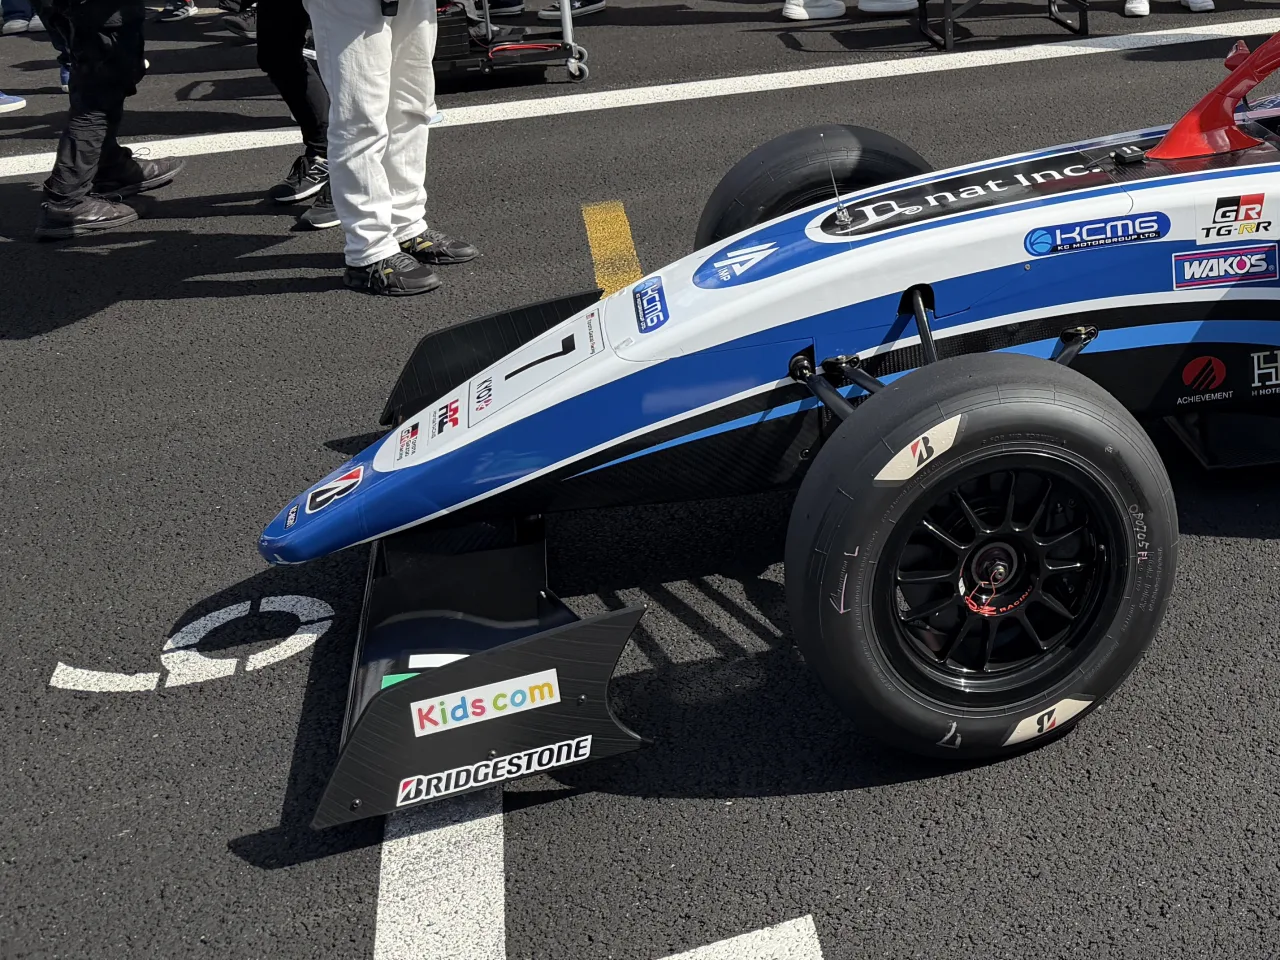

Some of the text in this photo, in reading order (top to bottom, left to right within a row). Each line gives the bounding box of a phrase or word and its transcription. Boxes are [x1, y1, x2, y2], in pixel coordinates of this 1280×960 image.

[1014, 165, 1101, 187] Inc.
[1214, 204, 1263, 224] GR
[1055, 216, 1158, 246] KCMG
[1072, 233, 1138, 248] MOTORGROUP
[1140, 231, 1159, 239] LTD.
[1201, 220, 1272, 239] TG-RR
[717, 267, 731, 282] IMP
[641, 284, 664, 327] KCMG
[504, 333, 576, 381] 7
[1177, 391, 1234, 405] ACHIEVEMENT
[437, 398, 460, 435] HRC
[417, 681, 554, 730] Kids com
[399, 737, 590, 803] BRIDGESTONE
